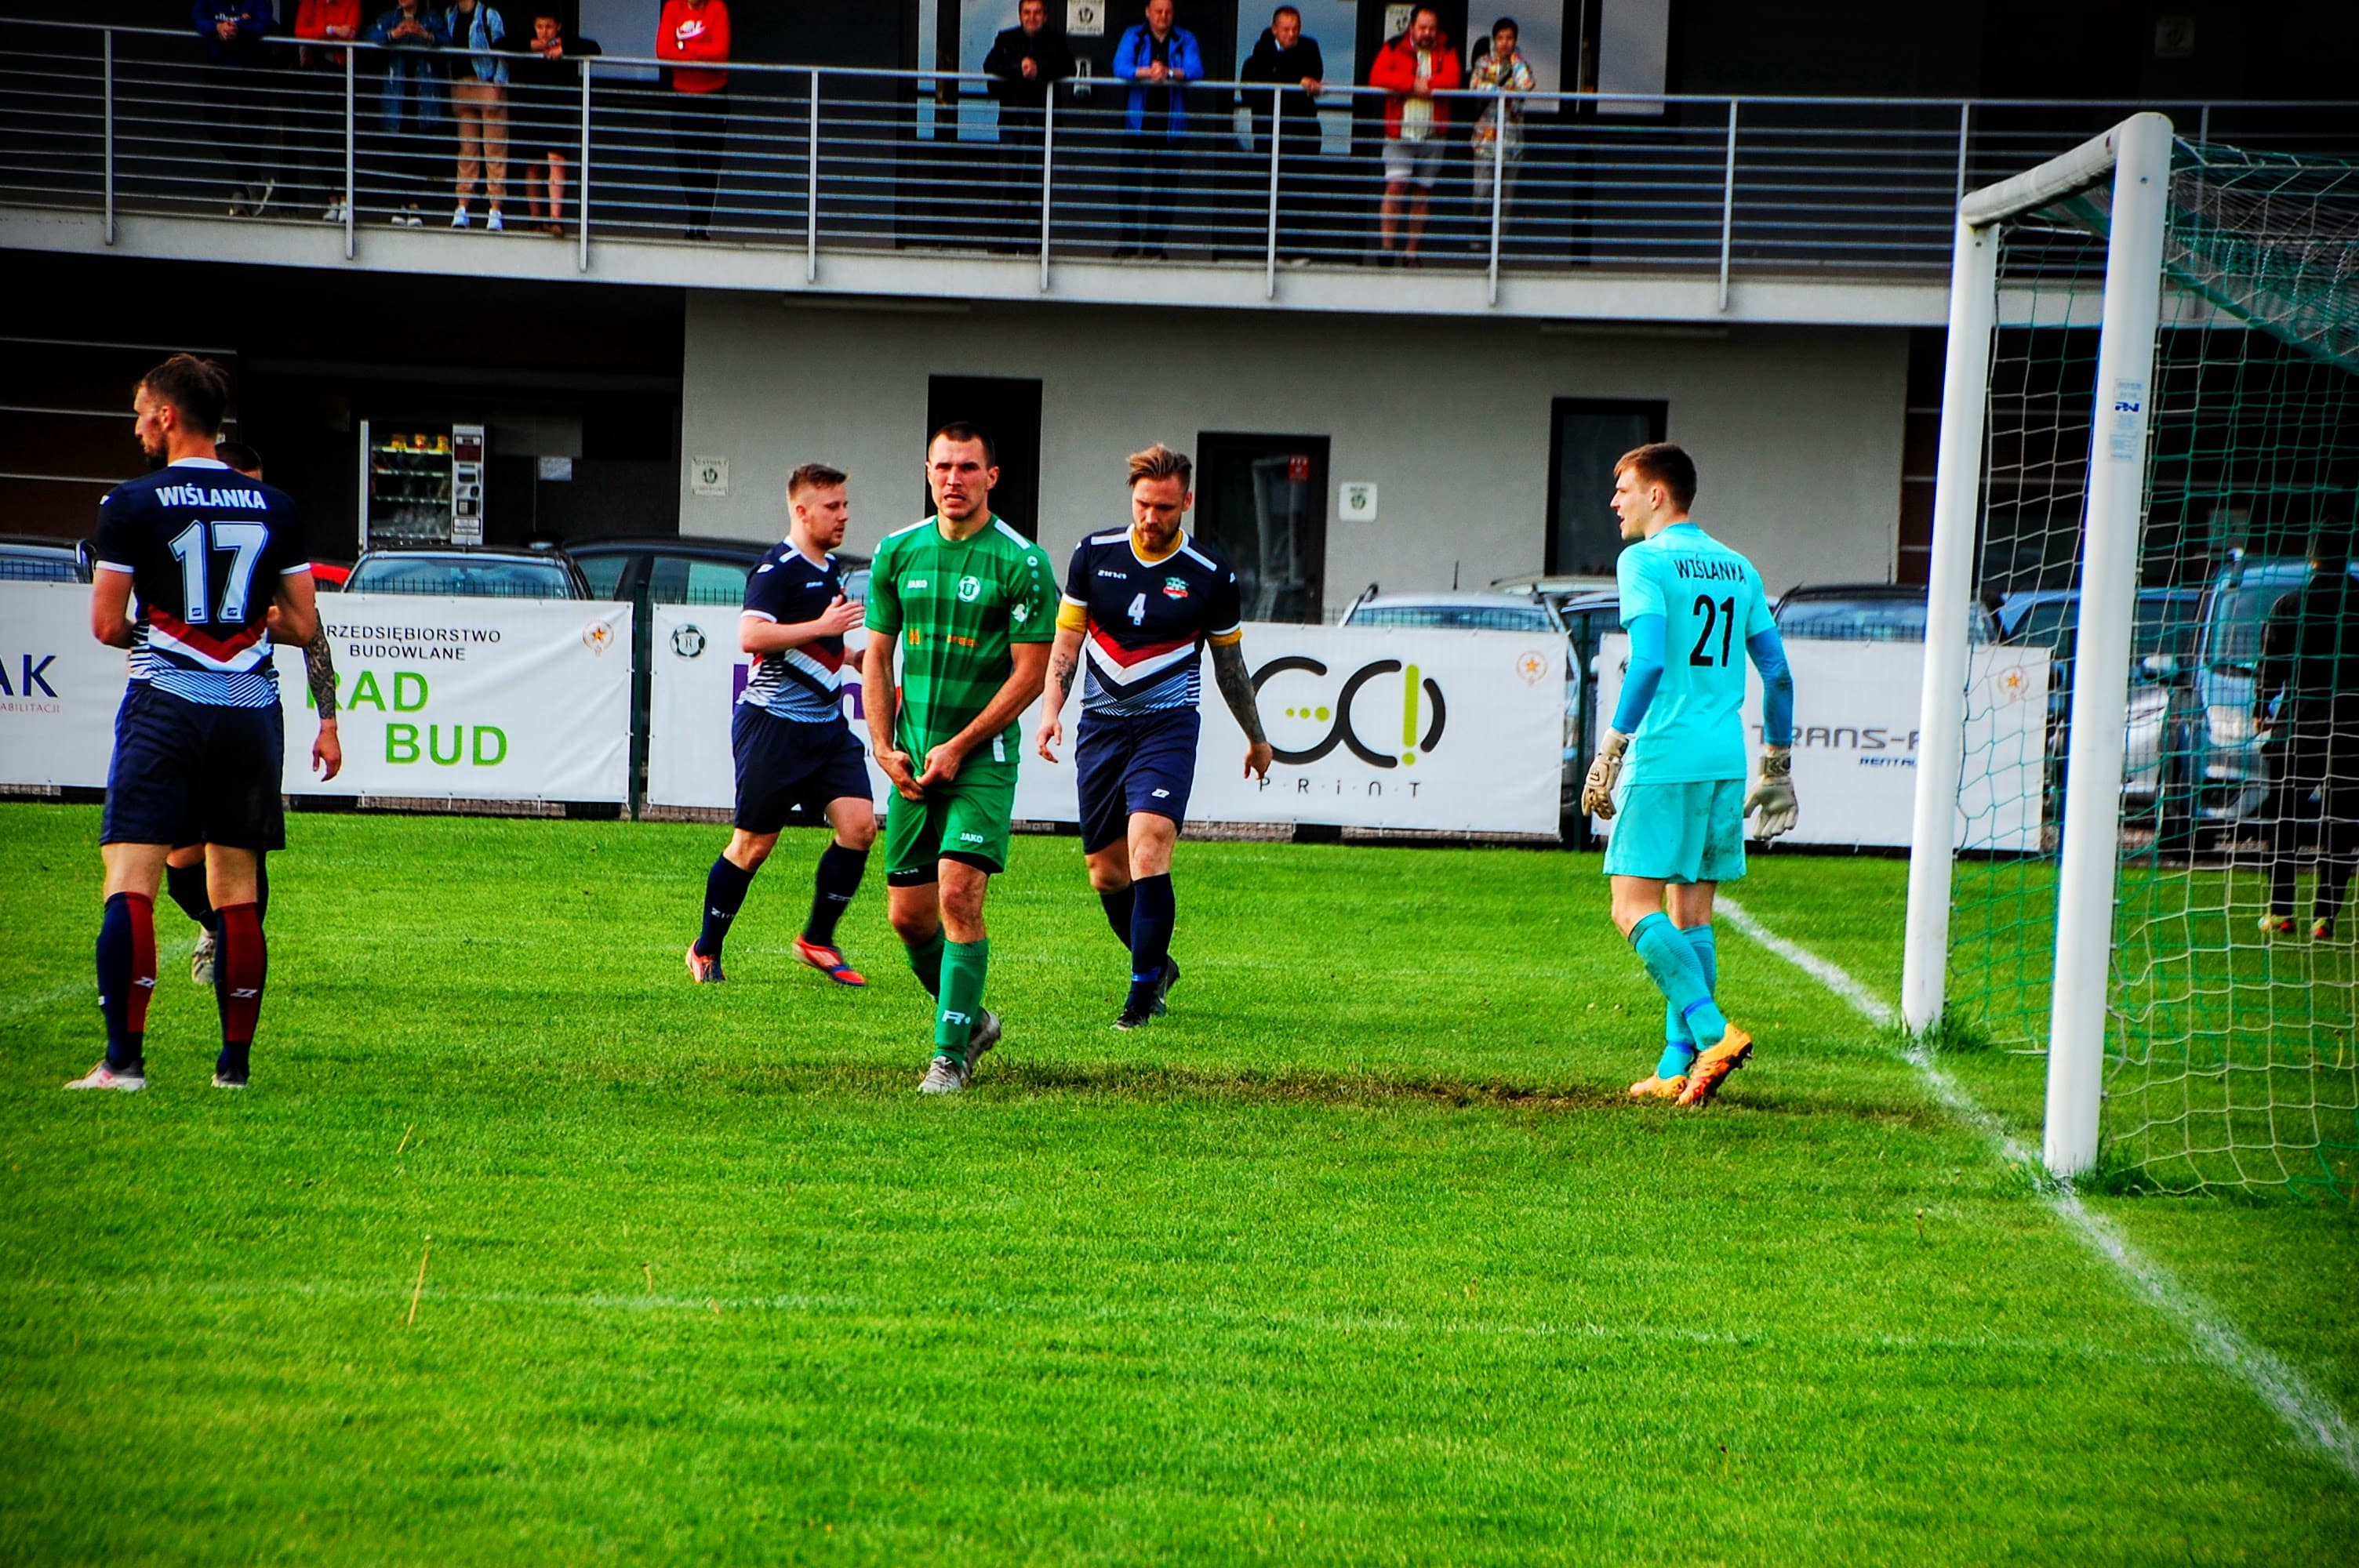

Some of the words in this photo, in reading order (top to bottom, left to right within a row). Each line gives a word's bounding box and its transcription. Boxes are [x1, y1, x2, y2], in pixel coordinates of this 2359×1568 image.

[156, 482, 267, 510] WIŚLANKA
[168, 519, 268, 624] 17
[1128, 593, 1147, 626] 4
[326, 625, 501, 644] RZEDSIĘBIORSTWO
[1689, 594, 1735, 668] 21
[350, 644, 467, 661] BUDOWLANE
[385, 722, 508, 767] BUD
[960, 832, 984, 844] JAKO
